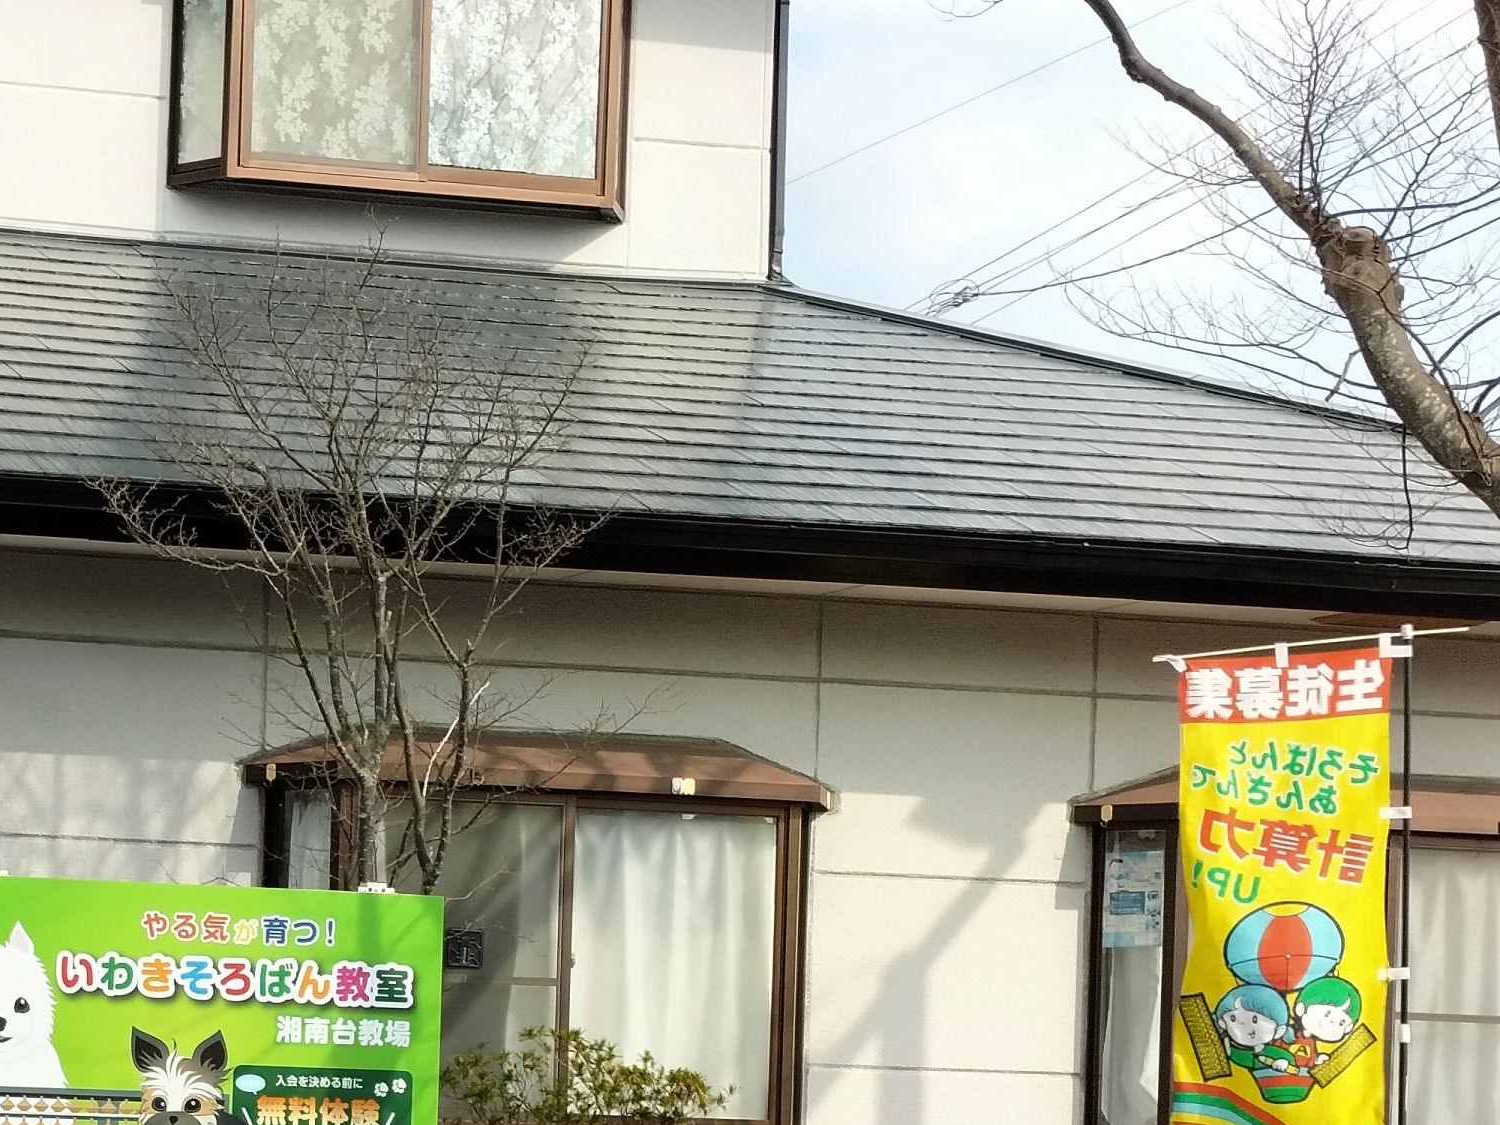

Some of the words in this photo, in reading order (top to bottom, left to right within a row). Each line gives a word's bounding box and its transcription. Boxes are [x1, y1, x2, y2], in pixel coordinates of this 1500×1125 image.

[143, 912, 334, 945] やる気が育つ！
[60, 955, 409, 1004] いわきそろばん教室
[275, 1015, 412, 1048] 湘南台教場
[275, 1074, 364, 1090] 入会を決める前に
